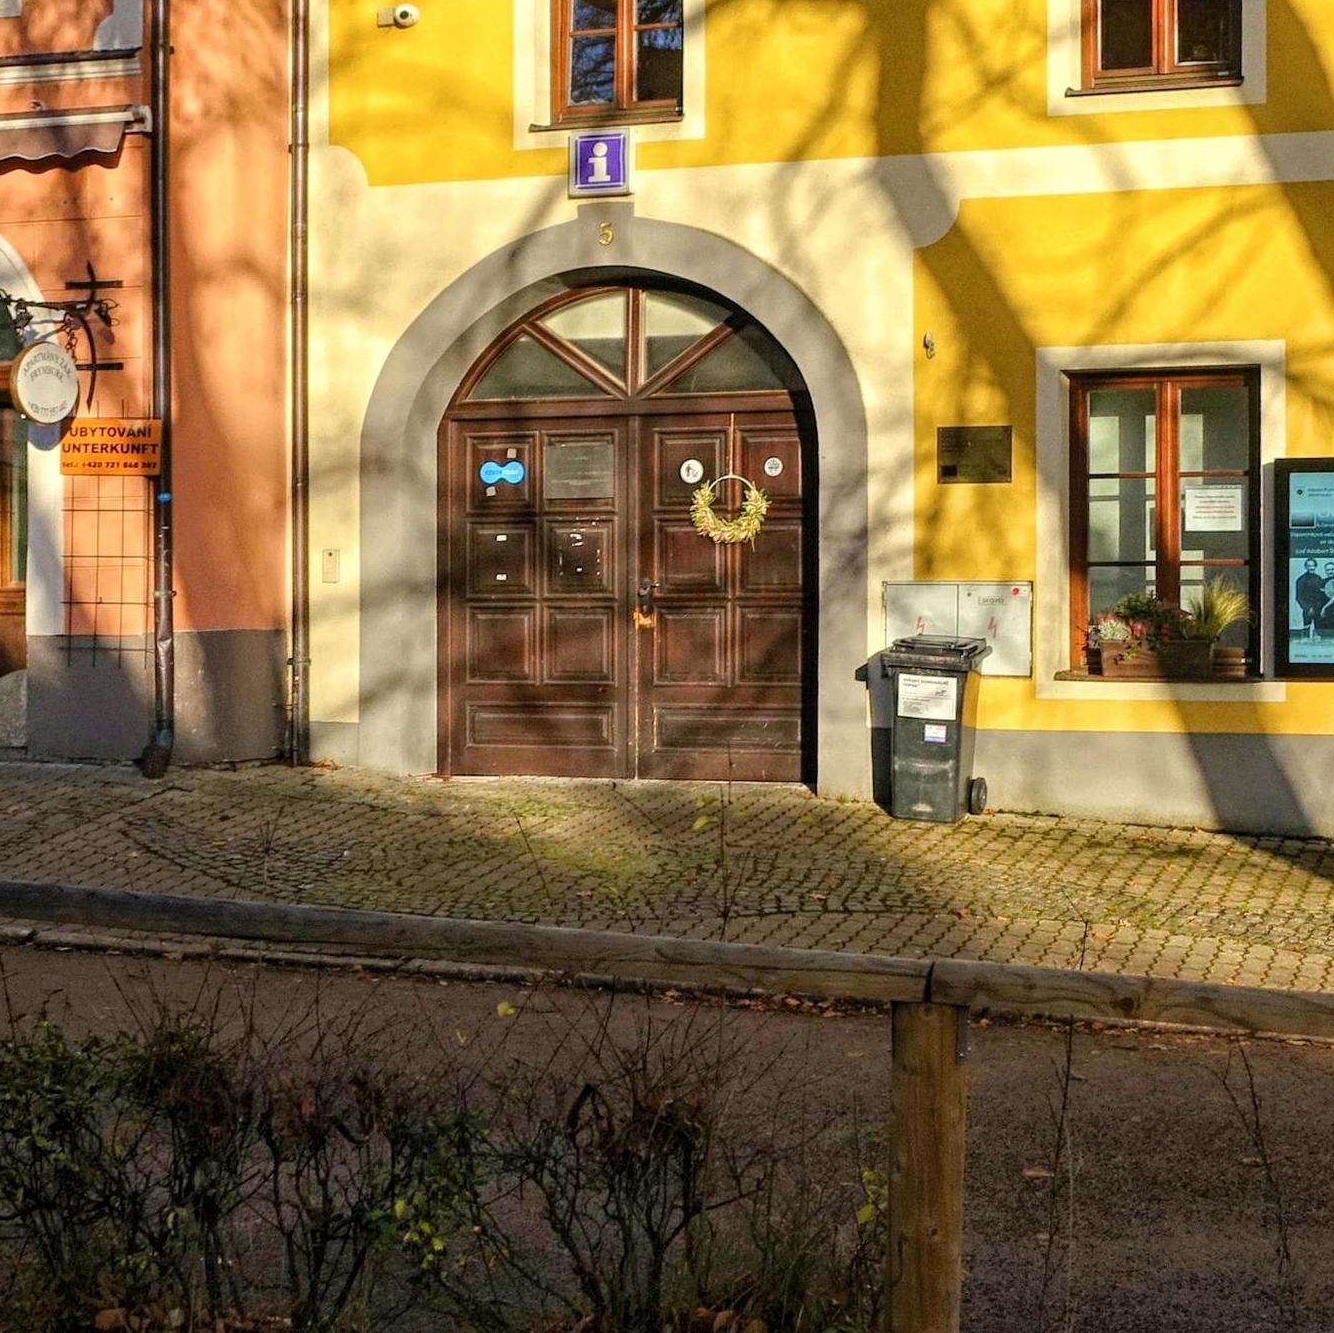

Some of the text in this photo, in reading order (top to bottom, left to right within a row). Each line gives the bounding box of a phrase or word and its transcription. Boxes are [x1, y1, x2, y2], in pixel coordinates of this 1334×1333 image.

[597, 219, 614, 246] 5
[69, 424, 152, 438] UBYTOVÁNÍ
[62, 443, 159, 454] UNTERKUNFT
